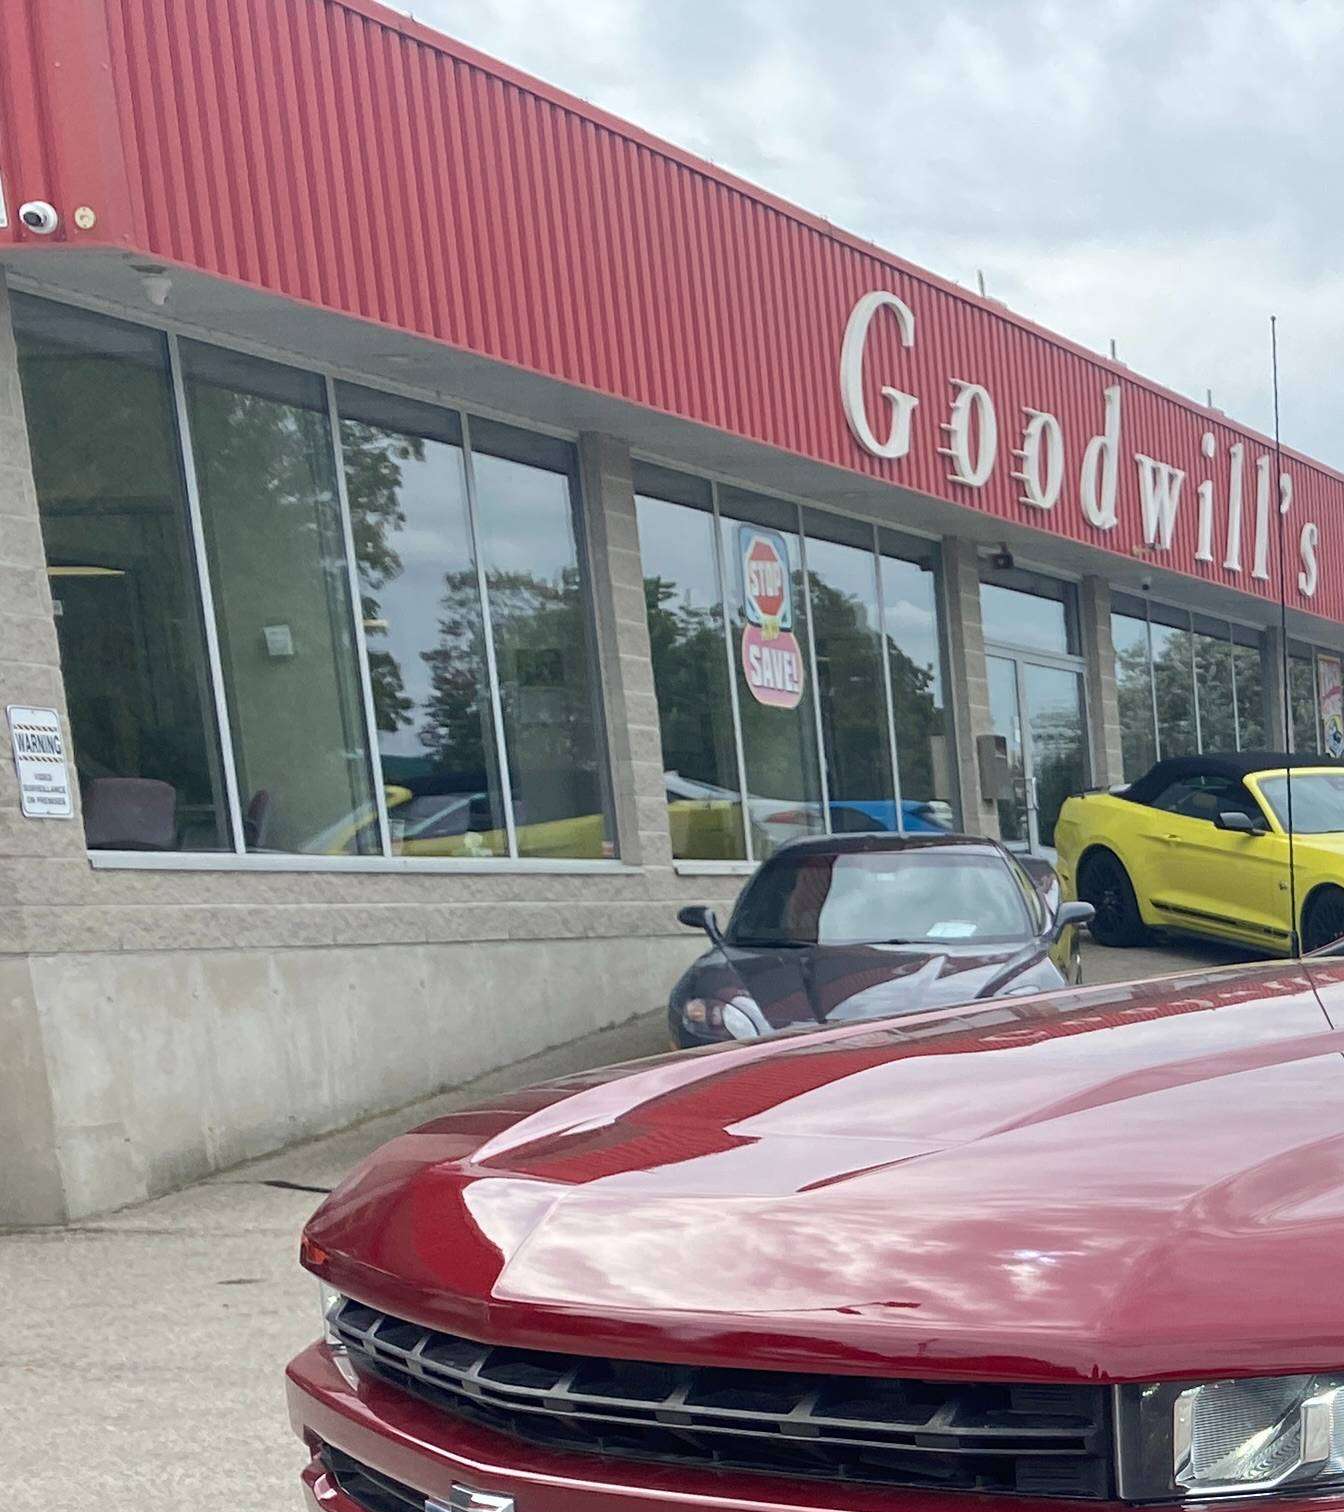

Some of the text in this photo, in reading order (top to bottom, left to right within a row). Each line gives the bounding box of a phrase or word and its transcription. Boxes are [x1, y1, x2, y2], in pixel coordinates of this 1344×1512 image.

[840, 289, 1321, 598] Goodwill's
[748, 561, 784, 598] STOP
[748, 643, 800, 693] SAVE!
[15, 733, 61, 755] WARNING
